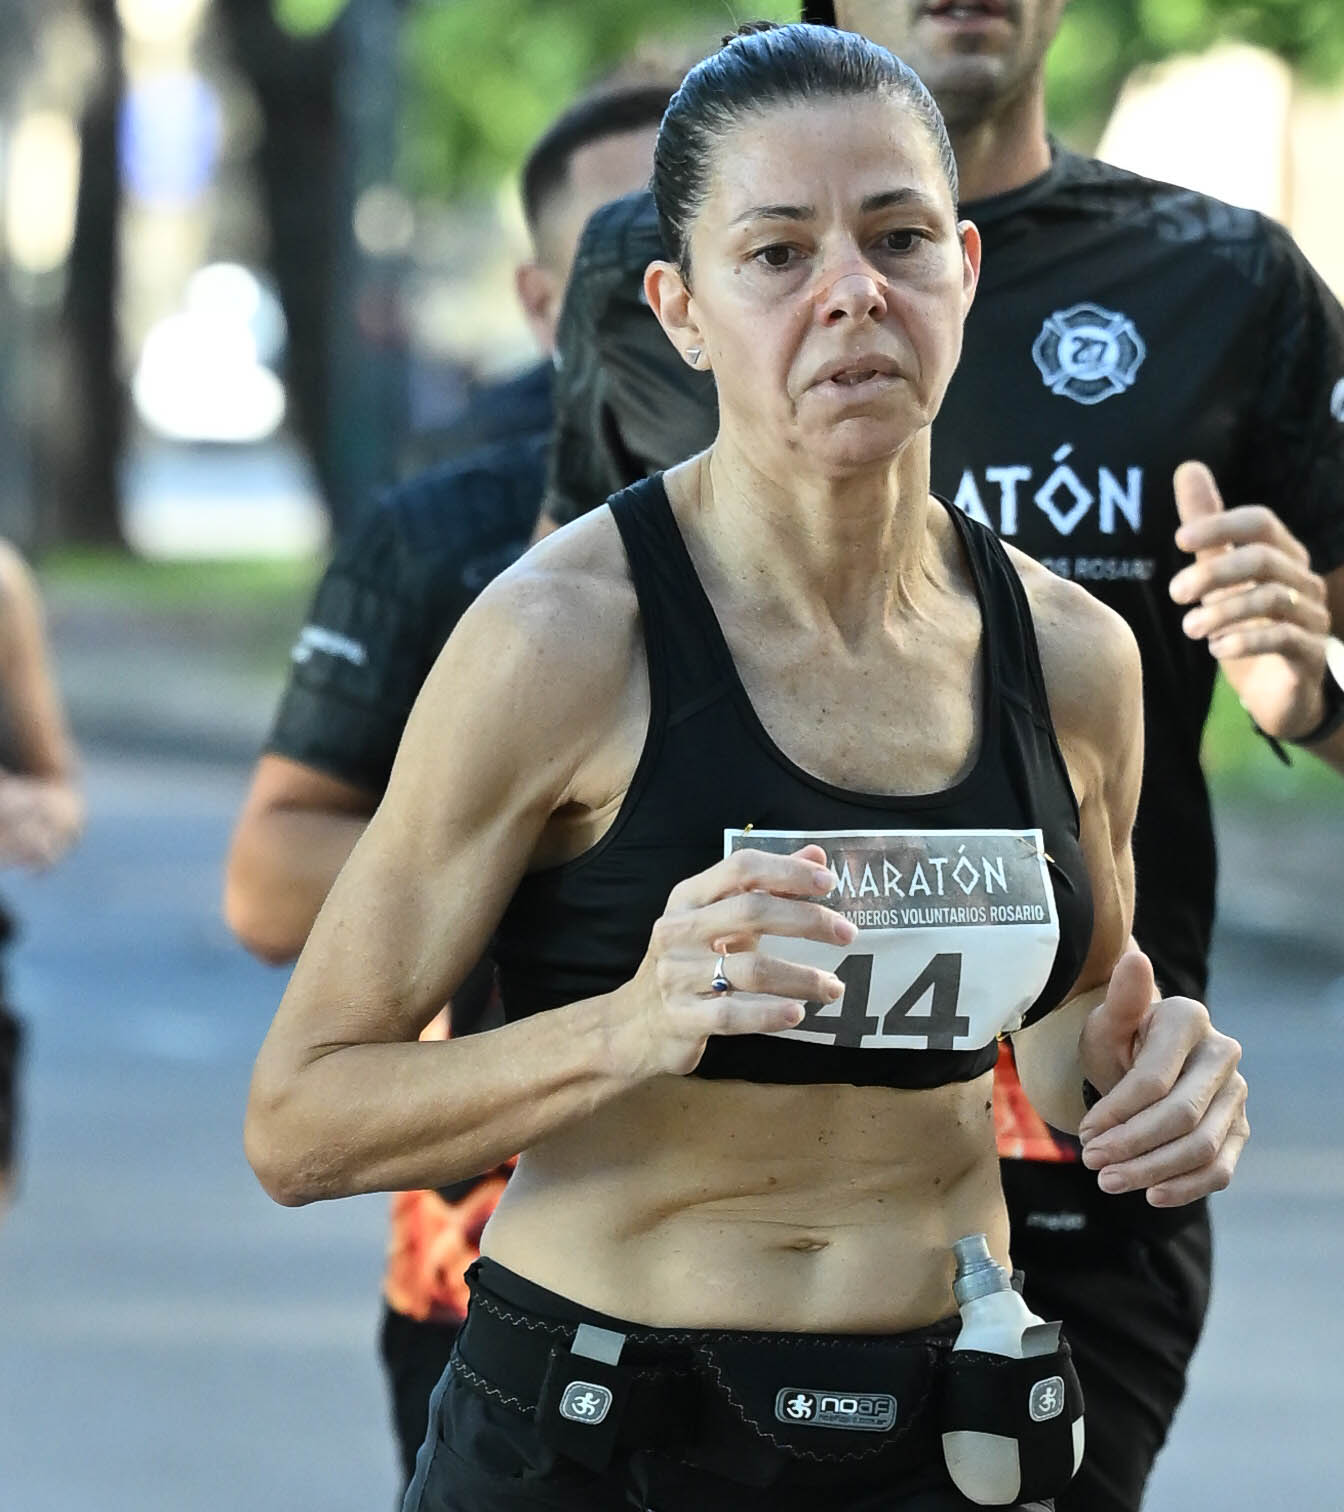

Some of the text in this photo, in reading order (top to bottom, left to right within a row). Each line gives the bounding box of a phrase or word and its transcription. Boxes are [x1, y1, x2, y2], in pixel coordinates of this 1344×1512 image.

[954, 442, 1144, 536] ATÓN
[827, 844, 1008, 899] MARATÓN
[840, 903, 1044, 926] OMBEROS VOLUNTARIOS ROSARIO
